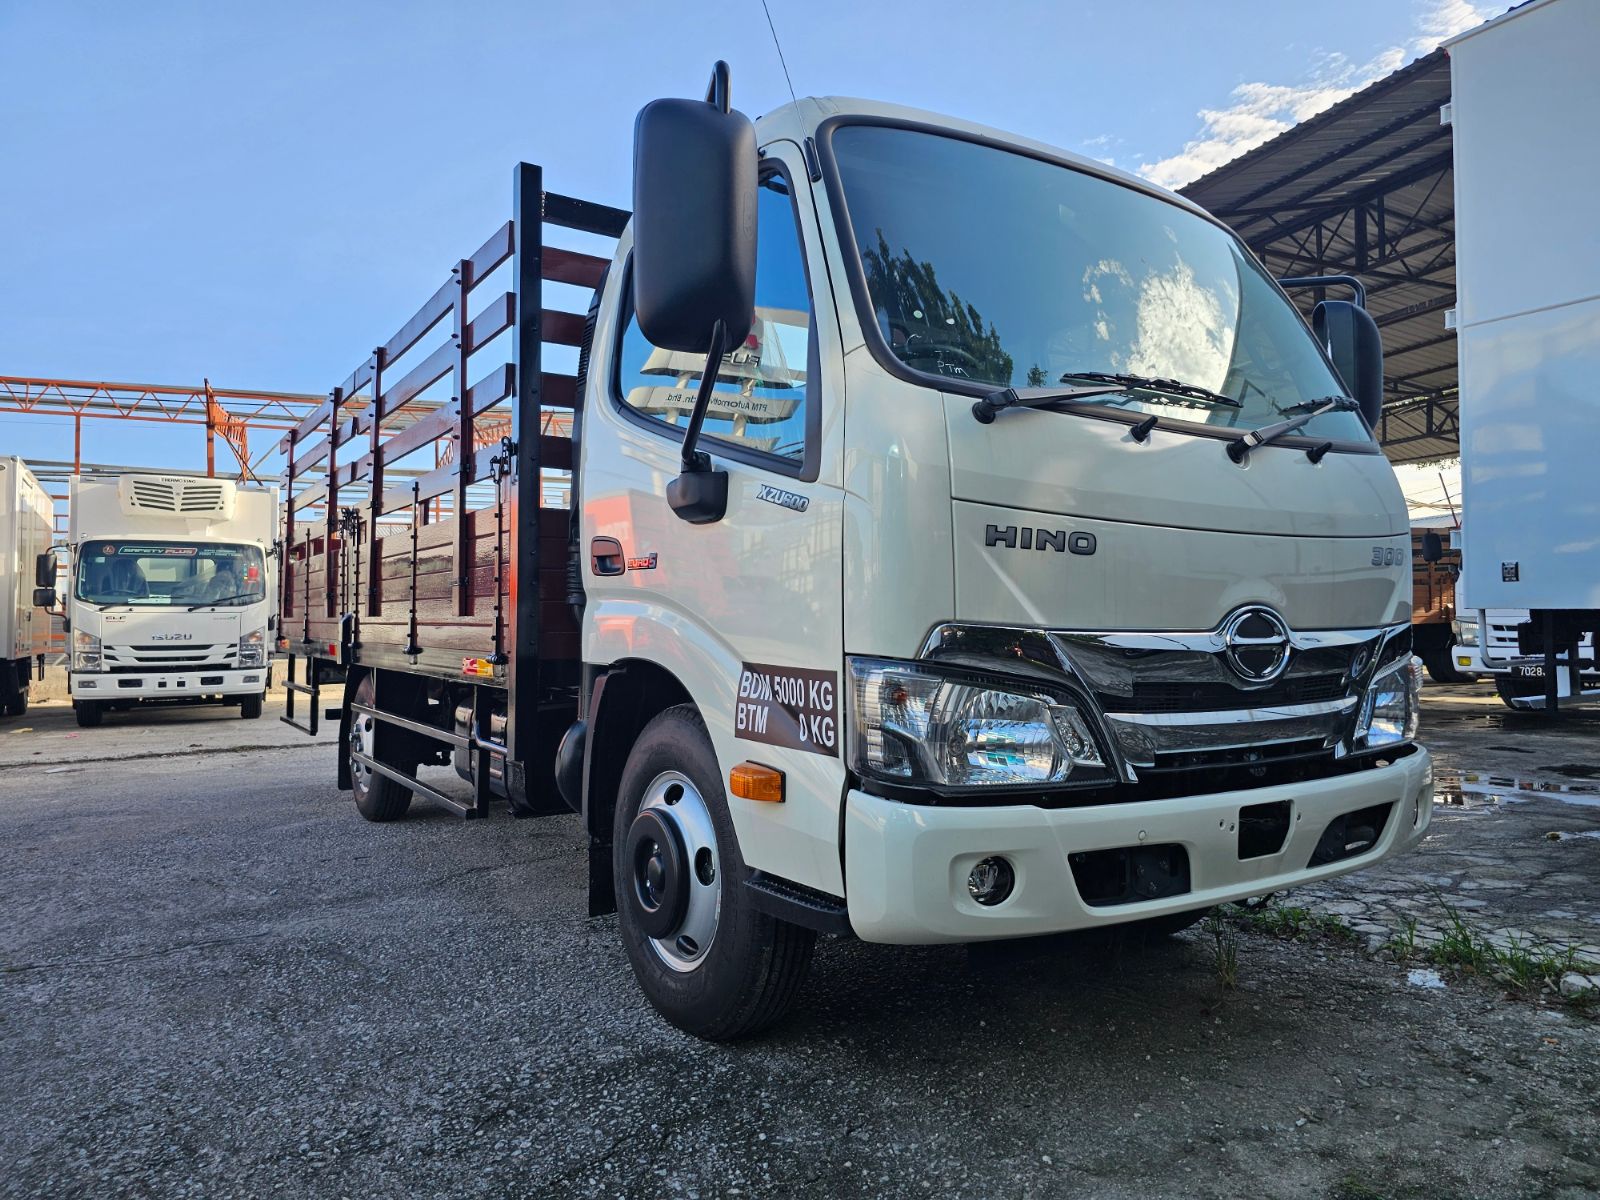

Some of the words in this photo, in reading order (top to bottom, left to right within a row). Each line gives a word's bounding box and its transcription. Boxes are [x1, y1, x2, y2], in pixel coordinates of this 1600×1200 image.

[757, 485, 809, 511] XZU600
[985, 524, 1097, 555] HINO
[1371, 546, 1404, 566] 300
[151, 633, 192, 641] ISUZU
[1519, 666, 1545, 677] 7028
[739, 671, 772, 702] BDM
[774, 676, 804, 707] 5000
[809, 679, 833, 711] KG
[737, 702, 769, 734] BTM
[799, 713, 808, 742] 0
[810, 714, 834, 747] KG
